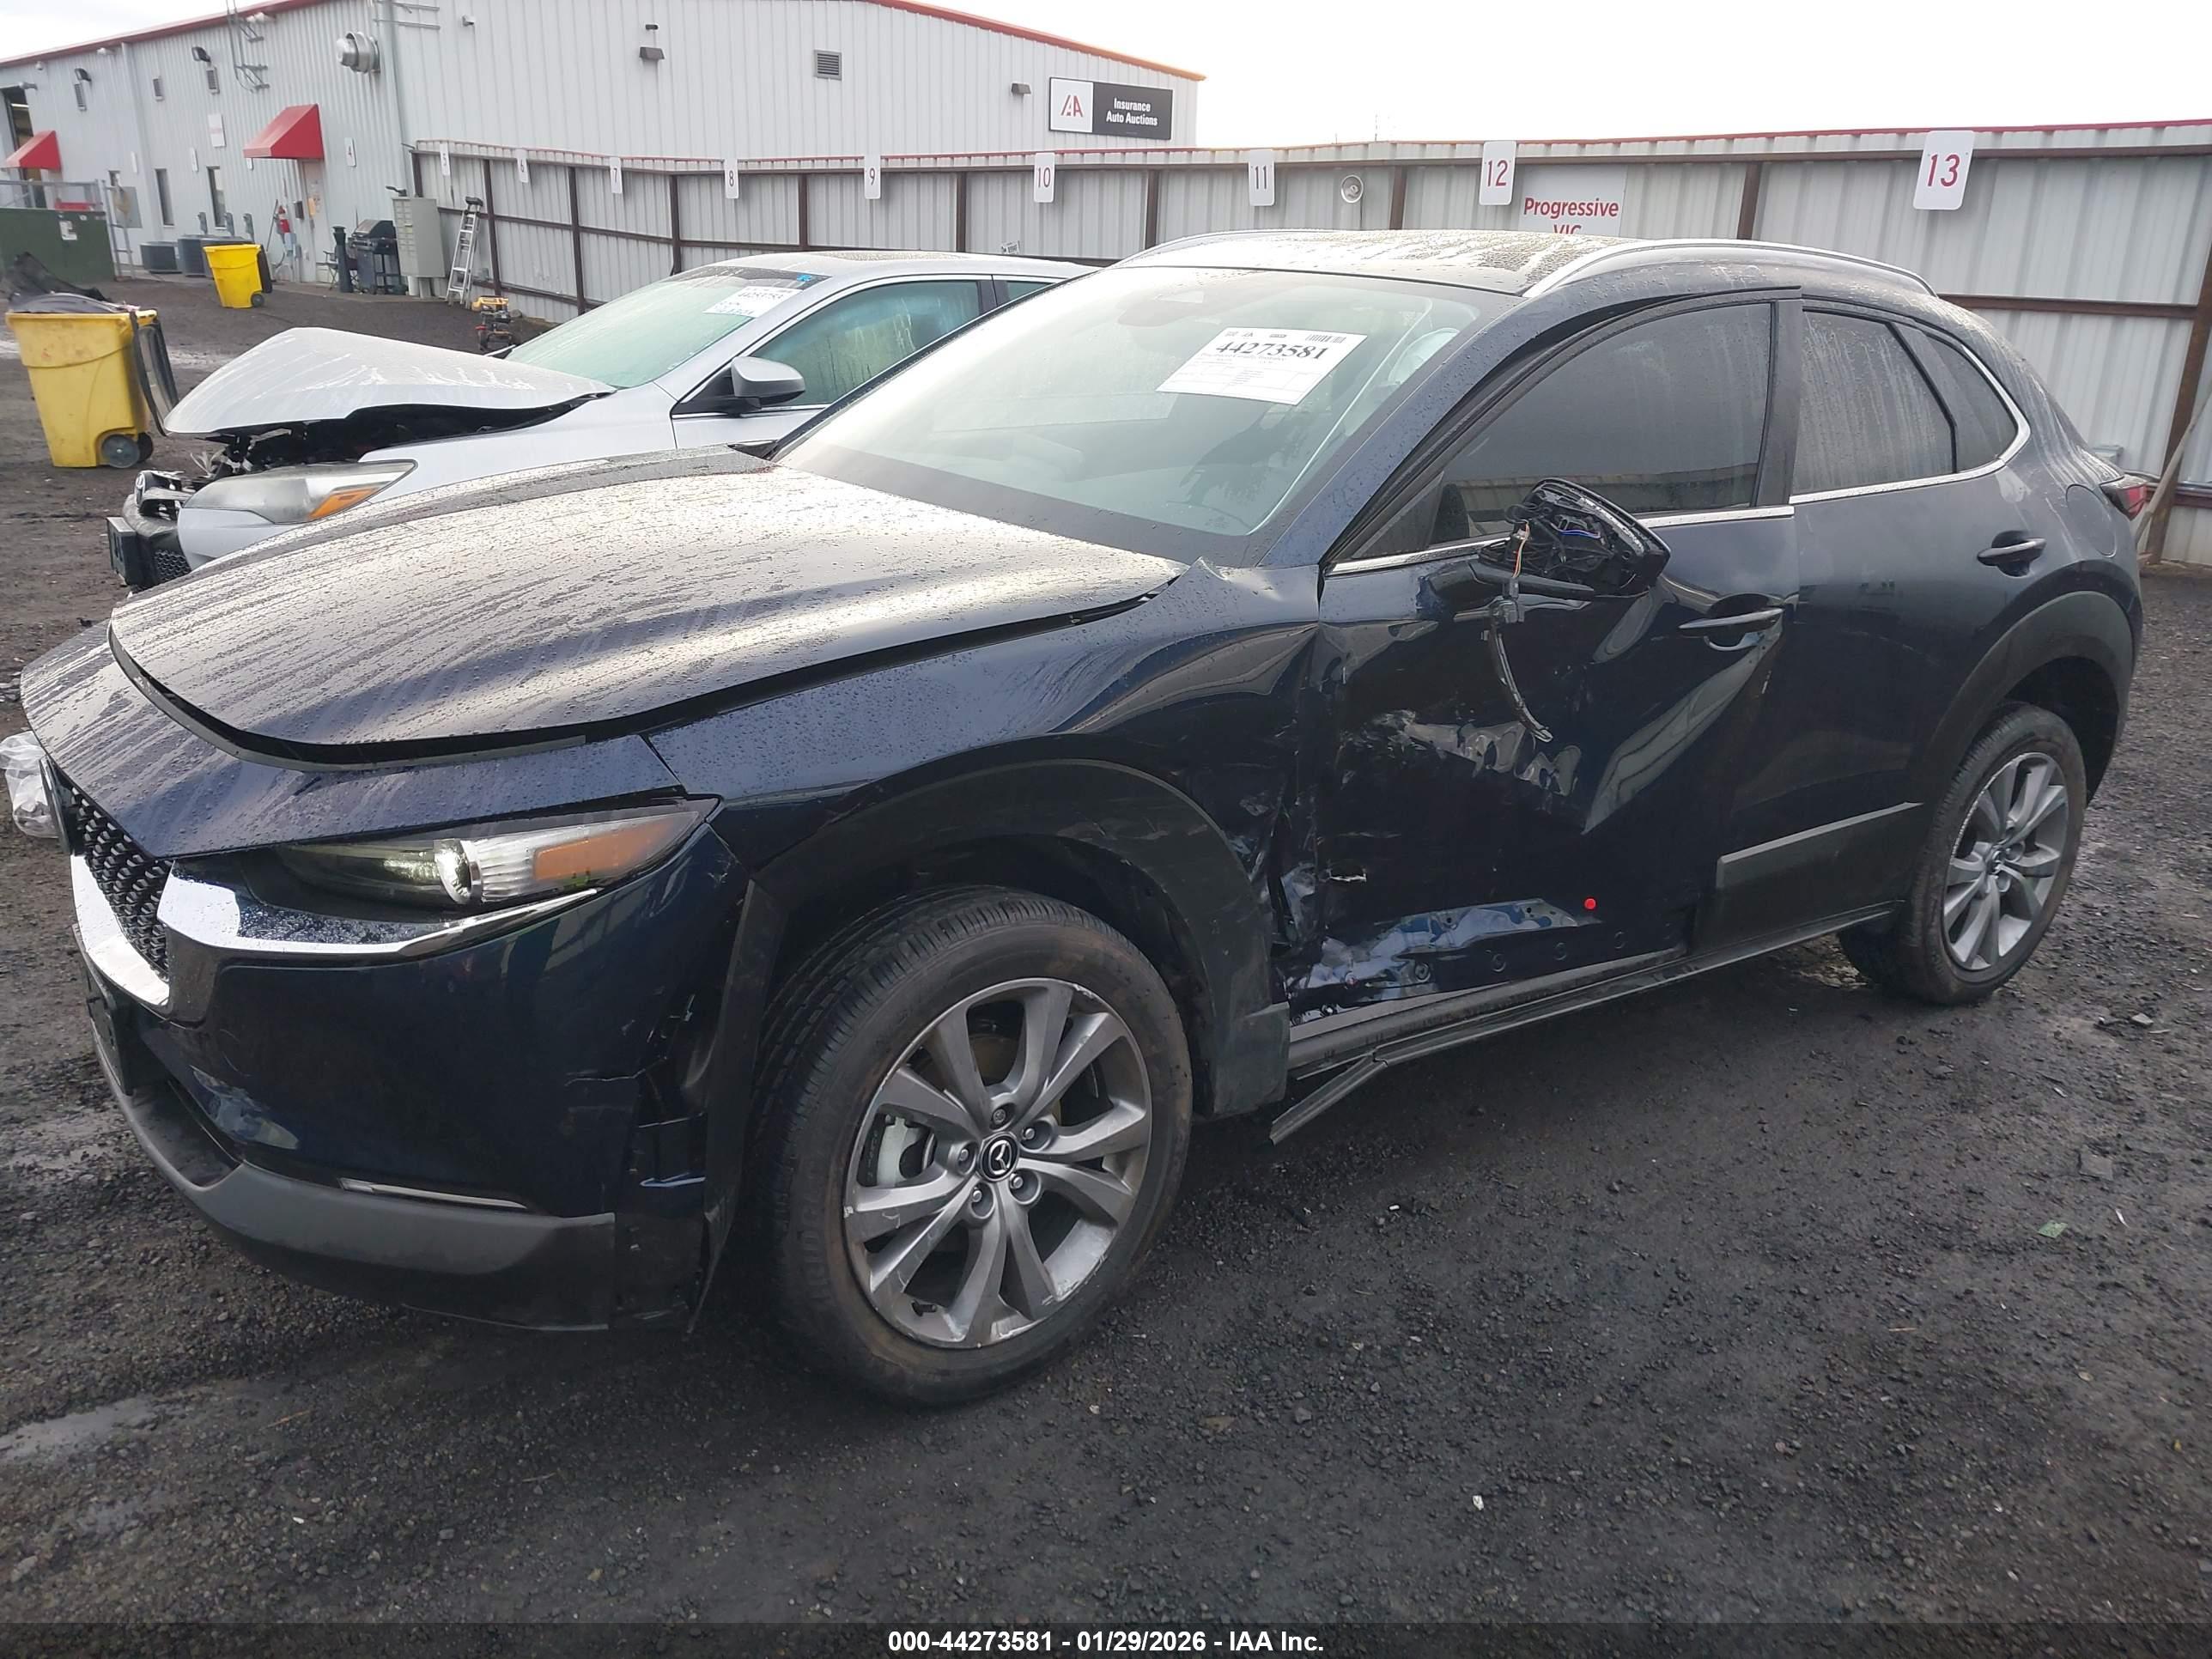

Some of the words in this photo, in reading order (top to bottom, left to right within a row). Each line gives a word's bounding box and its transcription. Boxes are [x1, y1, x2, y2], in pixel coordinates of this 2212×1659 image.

[1114, 97, 1152, 112] Insurance
[1106, 110, 1125, 124] Auto
[1125, 112, 1158, 126] Auctions
[728, 170, 735, 187] 8
[869, 167, 876, 186] 9
[1038, 167, 1051, 188] 10
[1255, 166, 1267, 190] 11
[1487, 160, 1509, 187] 12
[1928, 154, 1960, 187] 13
[1523, 198, 1620, 219] Progressive
[1215, 341, 1330, 360] 44273581
